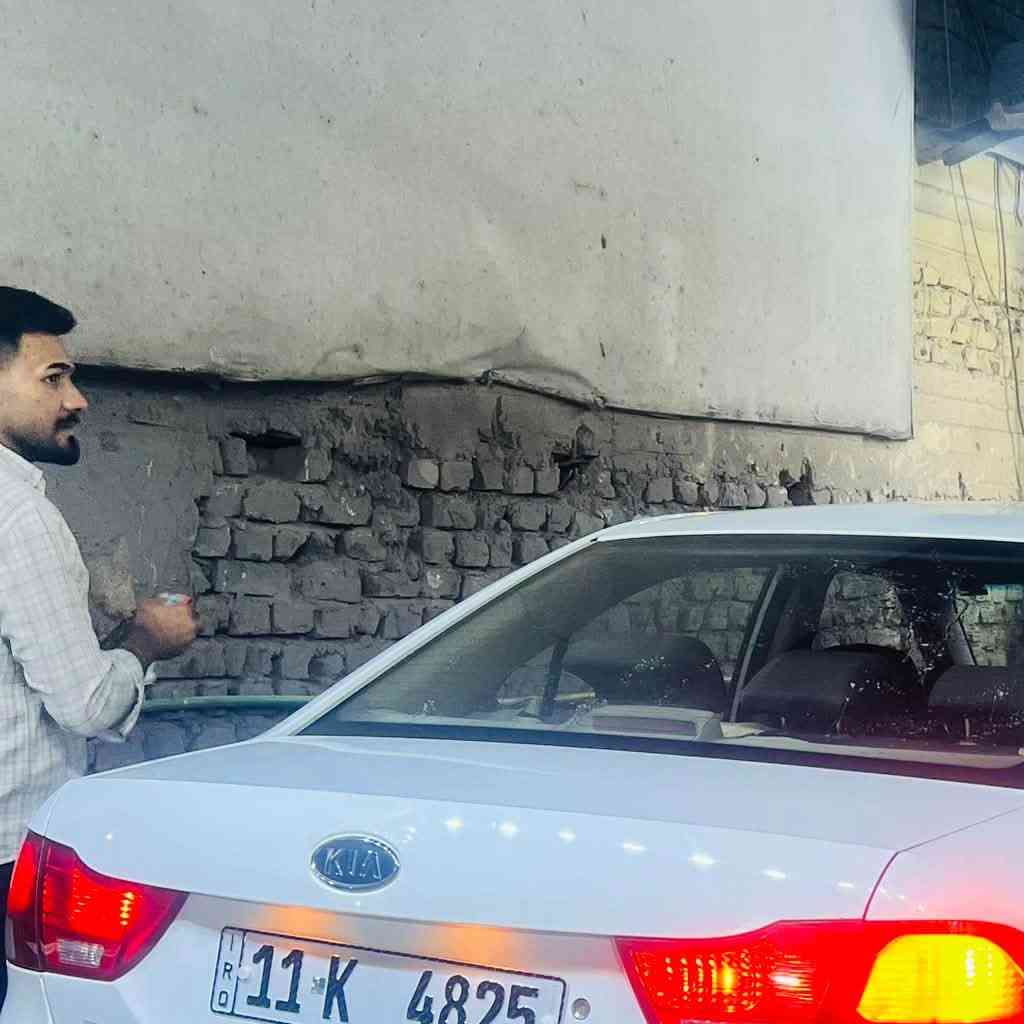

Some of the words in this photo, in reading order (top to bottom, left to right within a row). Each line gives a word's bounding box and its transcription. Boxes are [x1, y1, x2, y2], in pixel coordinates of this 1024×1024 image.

[323, 847, 383, 881] KIA
[246, 944, 304, 1014] 11
[322, 955, 359, 1023] K
